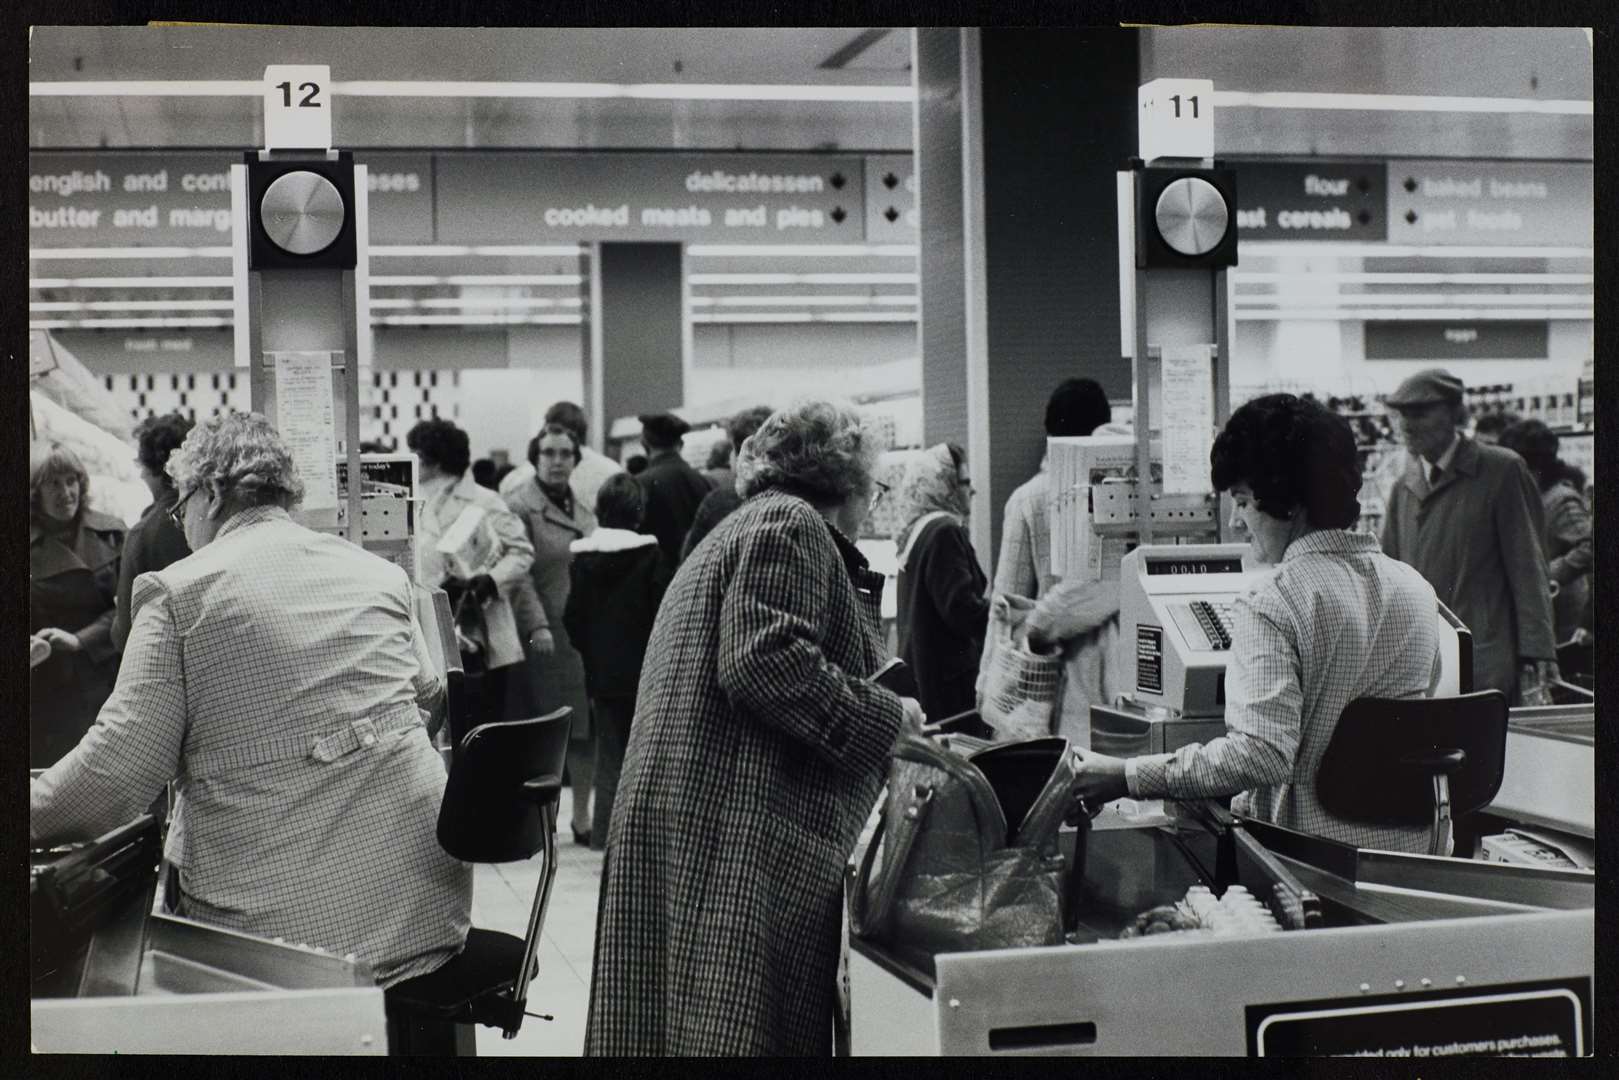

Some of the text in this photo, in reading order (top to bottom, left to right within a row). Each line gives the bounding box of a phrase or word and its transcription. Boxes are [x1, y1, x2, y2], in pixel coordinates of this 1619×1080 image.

[276, 82, 321, 107] 12
[1169, 95, 1198, 118] 11
[29, 170, 111, 196] english
[124, 170, 168, 192] and
[686, 171, 823, 192] delicatessen
[1304, 175, 1348, 195] flour
[29, 205, 232, 231] butter and marg
[545, 205, 823, 230] cooked meats and pies
[1237, 207, 1351, 229] ast cereals
[1413, 1044, 1430, 1057] for
[1433, 1038, 1496, 1056] customers
